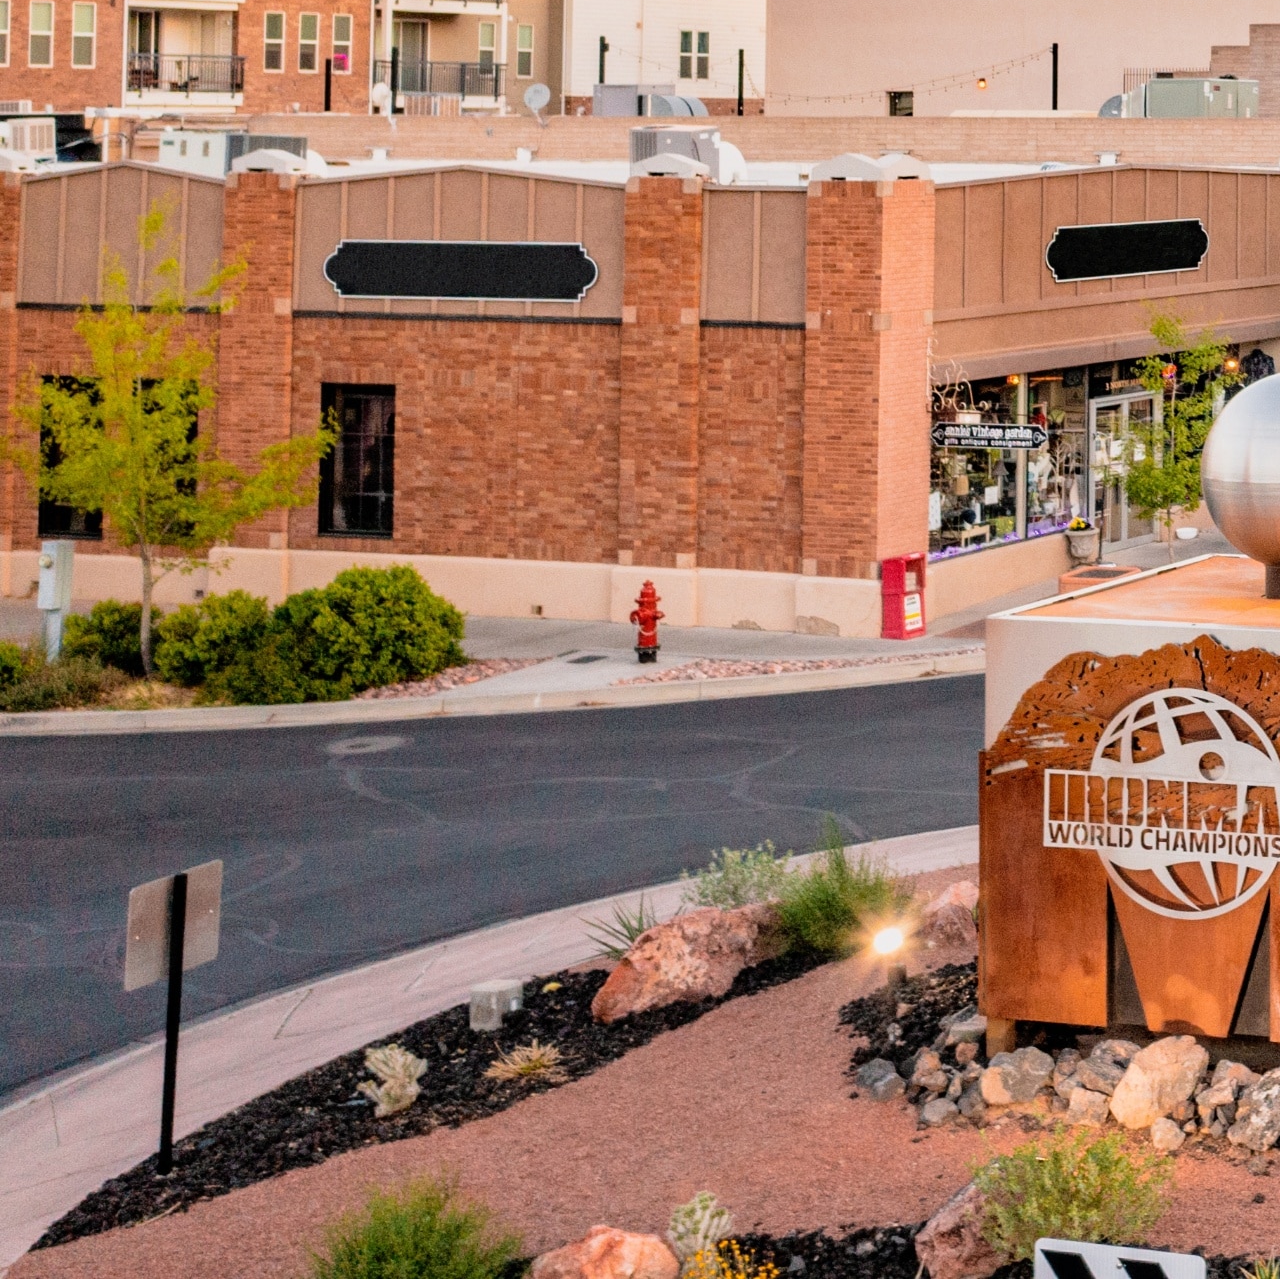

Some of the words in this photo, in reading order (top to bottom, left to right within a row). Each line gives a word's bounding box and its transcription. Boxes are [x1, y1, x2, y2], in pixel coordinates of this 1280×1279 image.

[971, 425, 1004, 439] vintage
[1004, 426, 1033, 440] garden
[944, 438, 959, 446] gifts
[960, 438, 988, 447] antiques
[990, 439, 1033, 448] consignment
[1048, 822, 1134, 849] WORLD
